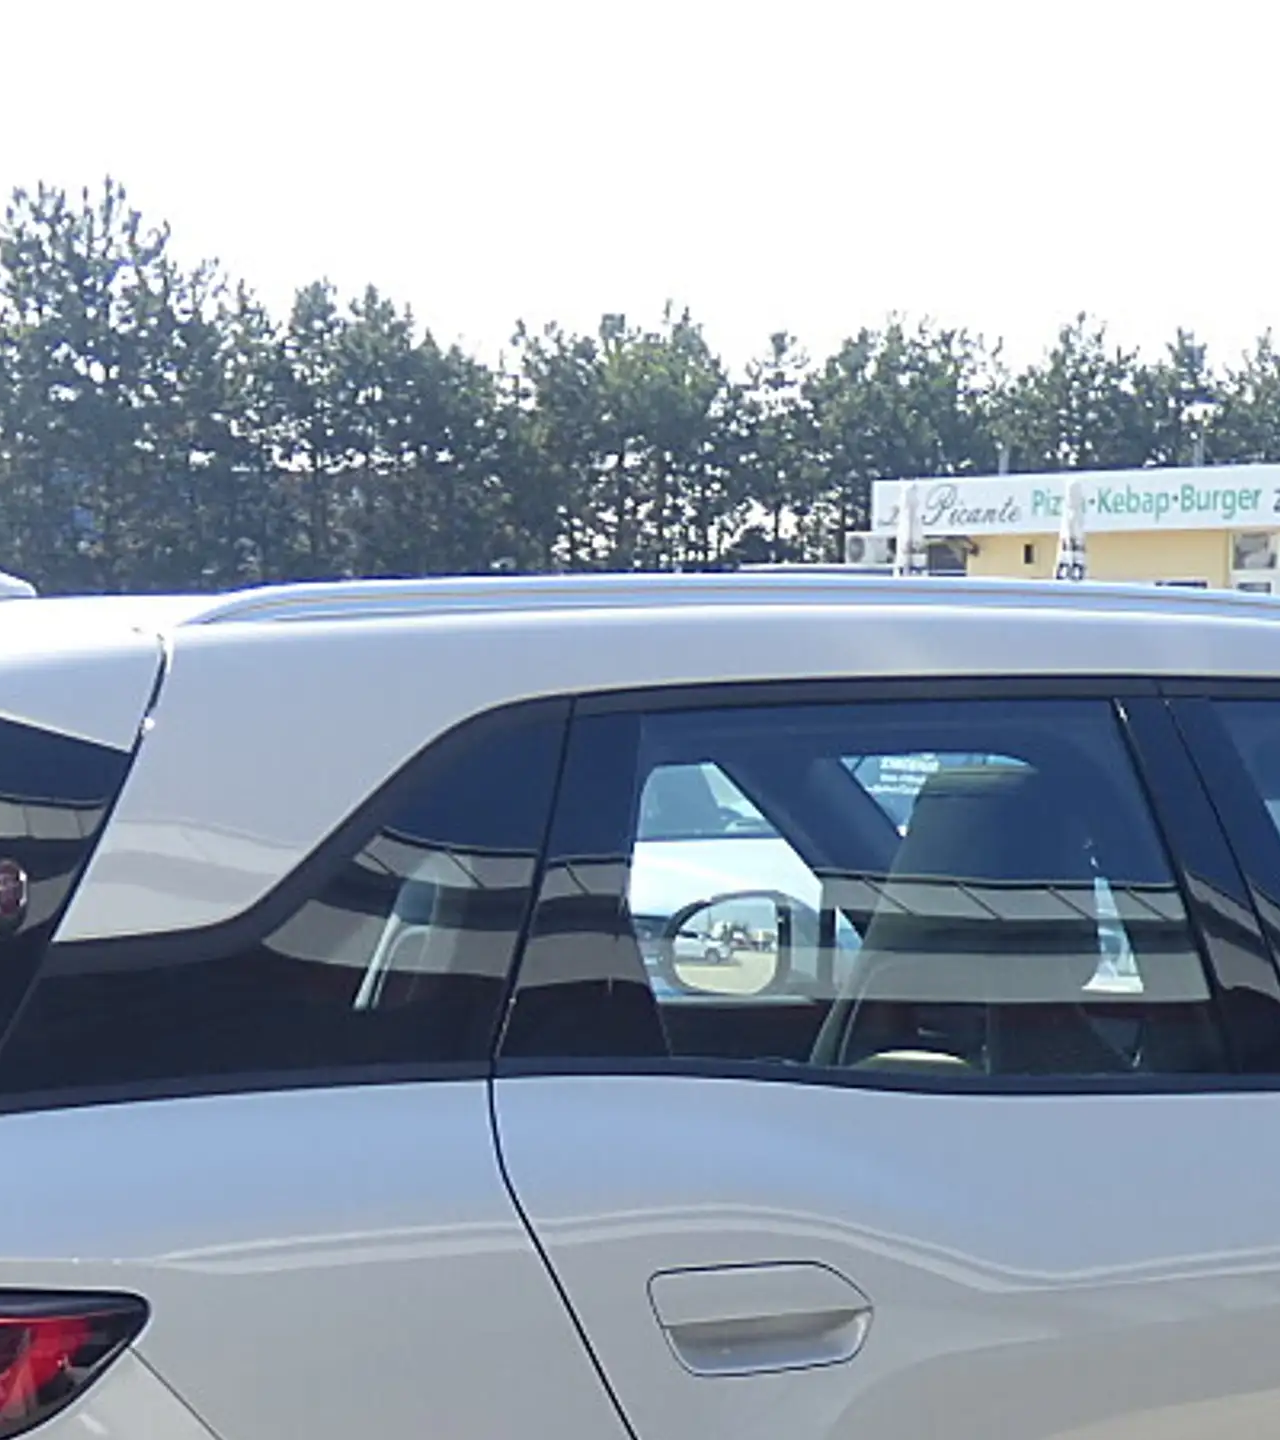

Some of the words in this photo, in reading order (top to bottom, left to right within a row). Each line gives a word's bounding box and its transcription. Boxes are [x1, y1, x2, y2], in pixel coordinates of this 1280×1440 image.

[921, 483, 1022, 527] Picante
[1032, 488, 1087, 517] Piz
[1097, 484, 1169, 522] Kebap
[1181, 483, 1262, 520] Burger
